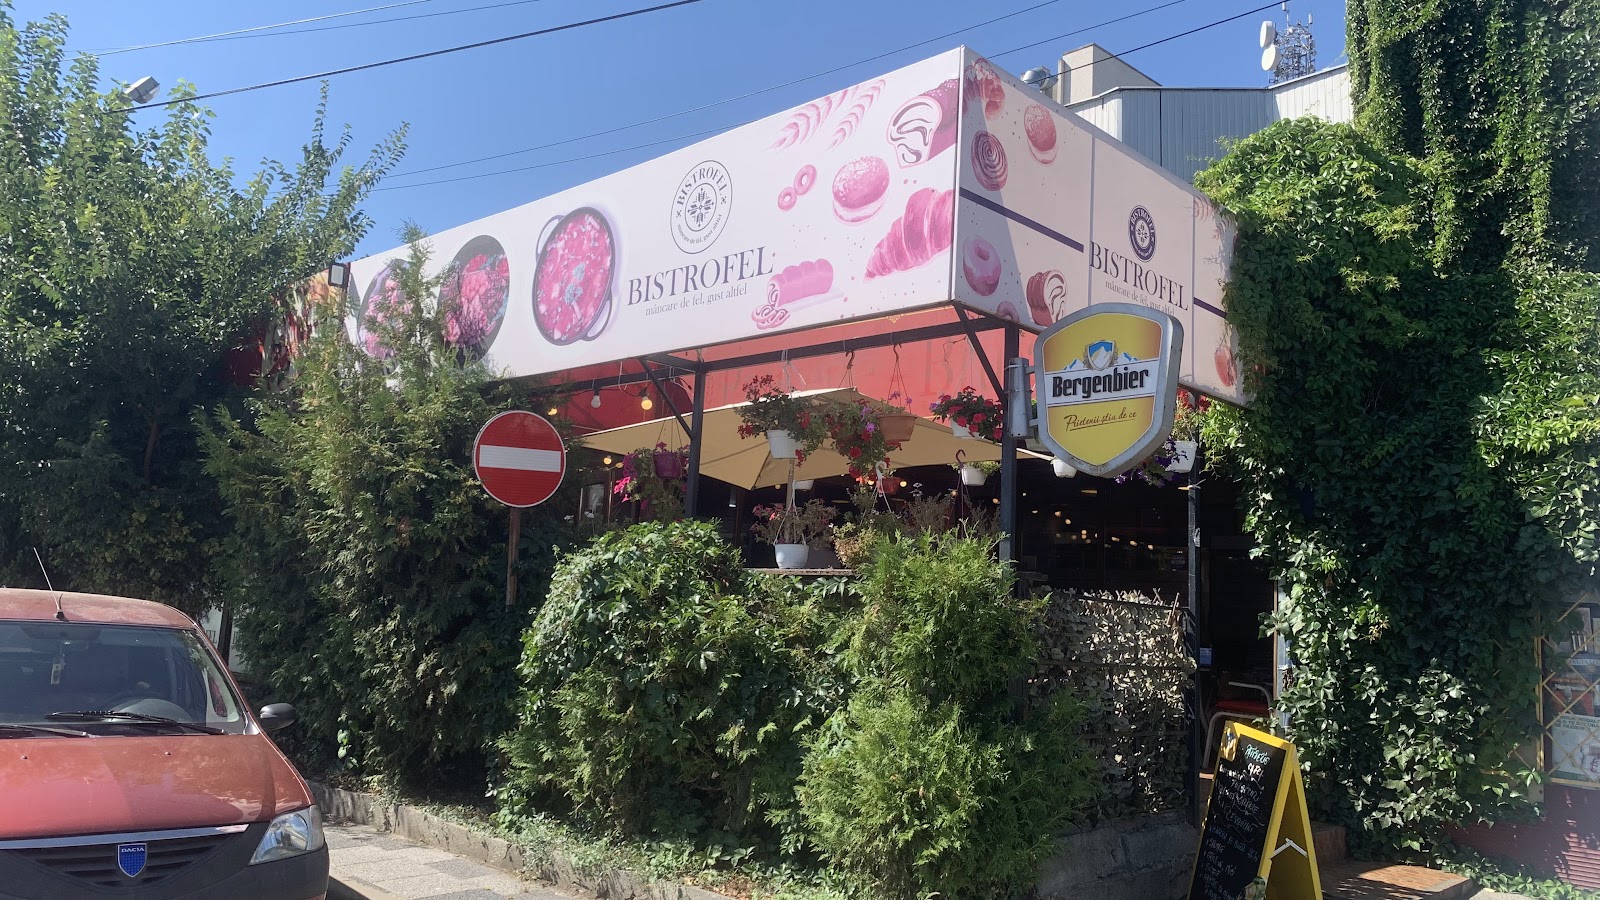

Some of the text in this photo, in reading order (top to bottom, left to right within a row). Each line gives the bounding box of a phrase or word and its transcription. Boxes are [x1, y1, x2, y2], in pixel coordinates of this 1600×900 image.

[677, 166, 727, 205] BISTROFEL
[627, 246, 774, 306] BISTROFEL
[1090, 240, 1188, 311] BISTROFEL
[1105, 280, 1131, 298] mâncare
[1131, 290, 1138, 301] de
[645, 283, 748, 316] mâncare de fel, gust altfel
[1052, 366, 1149, 398] Bergenbier
[1064, 414, 1100, 432] Prietenii
[1118, 406, 1127, 420] de
